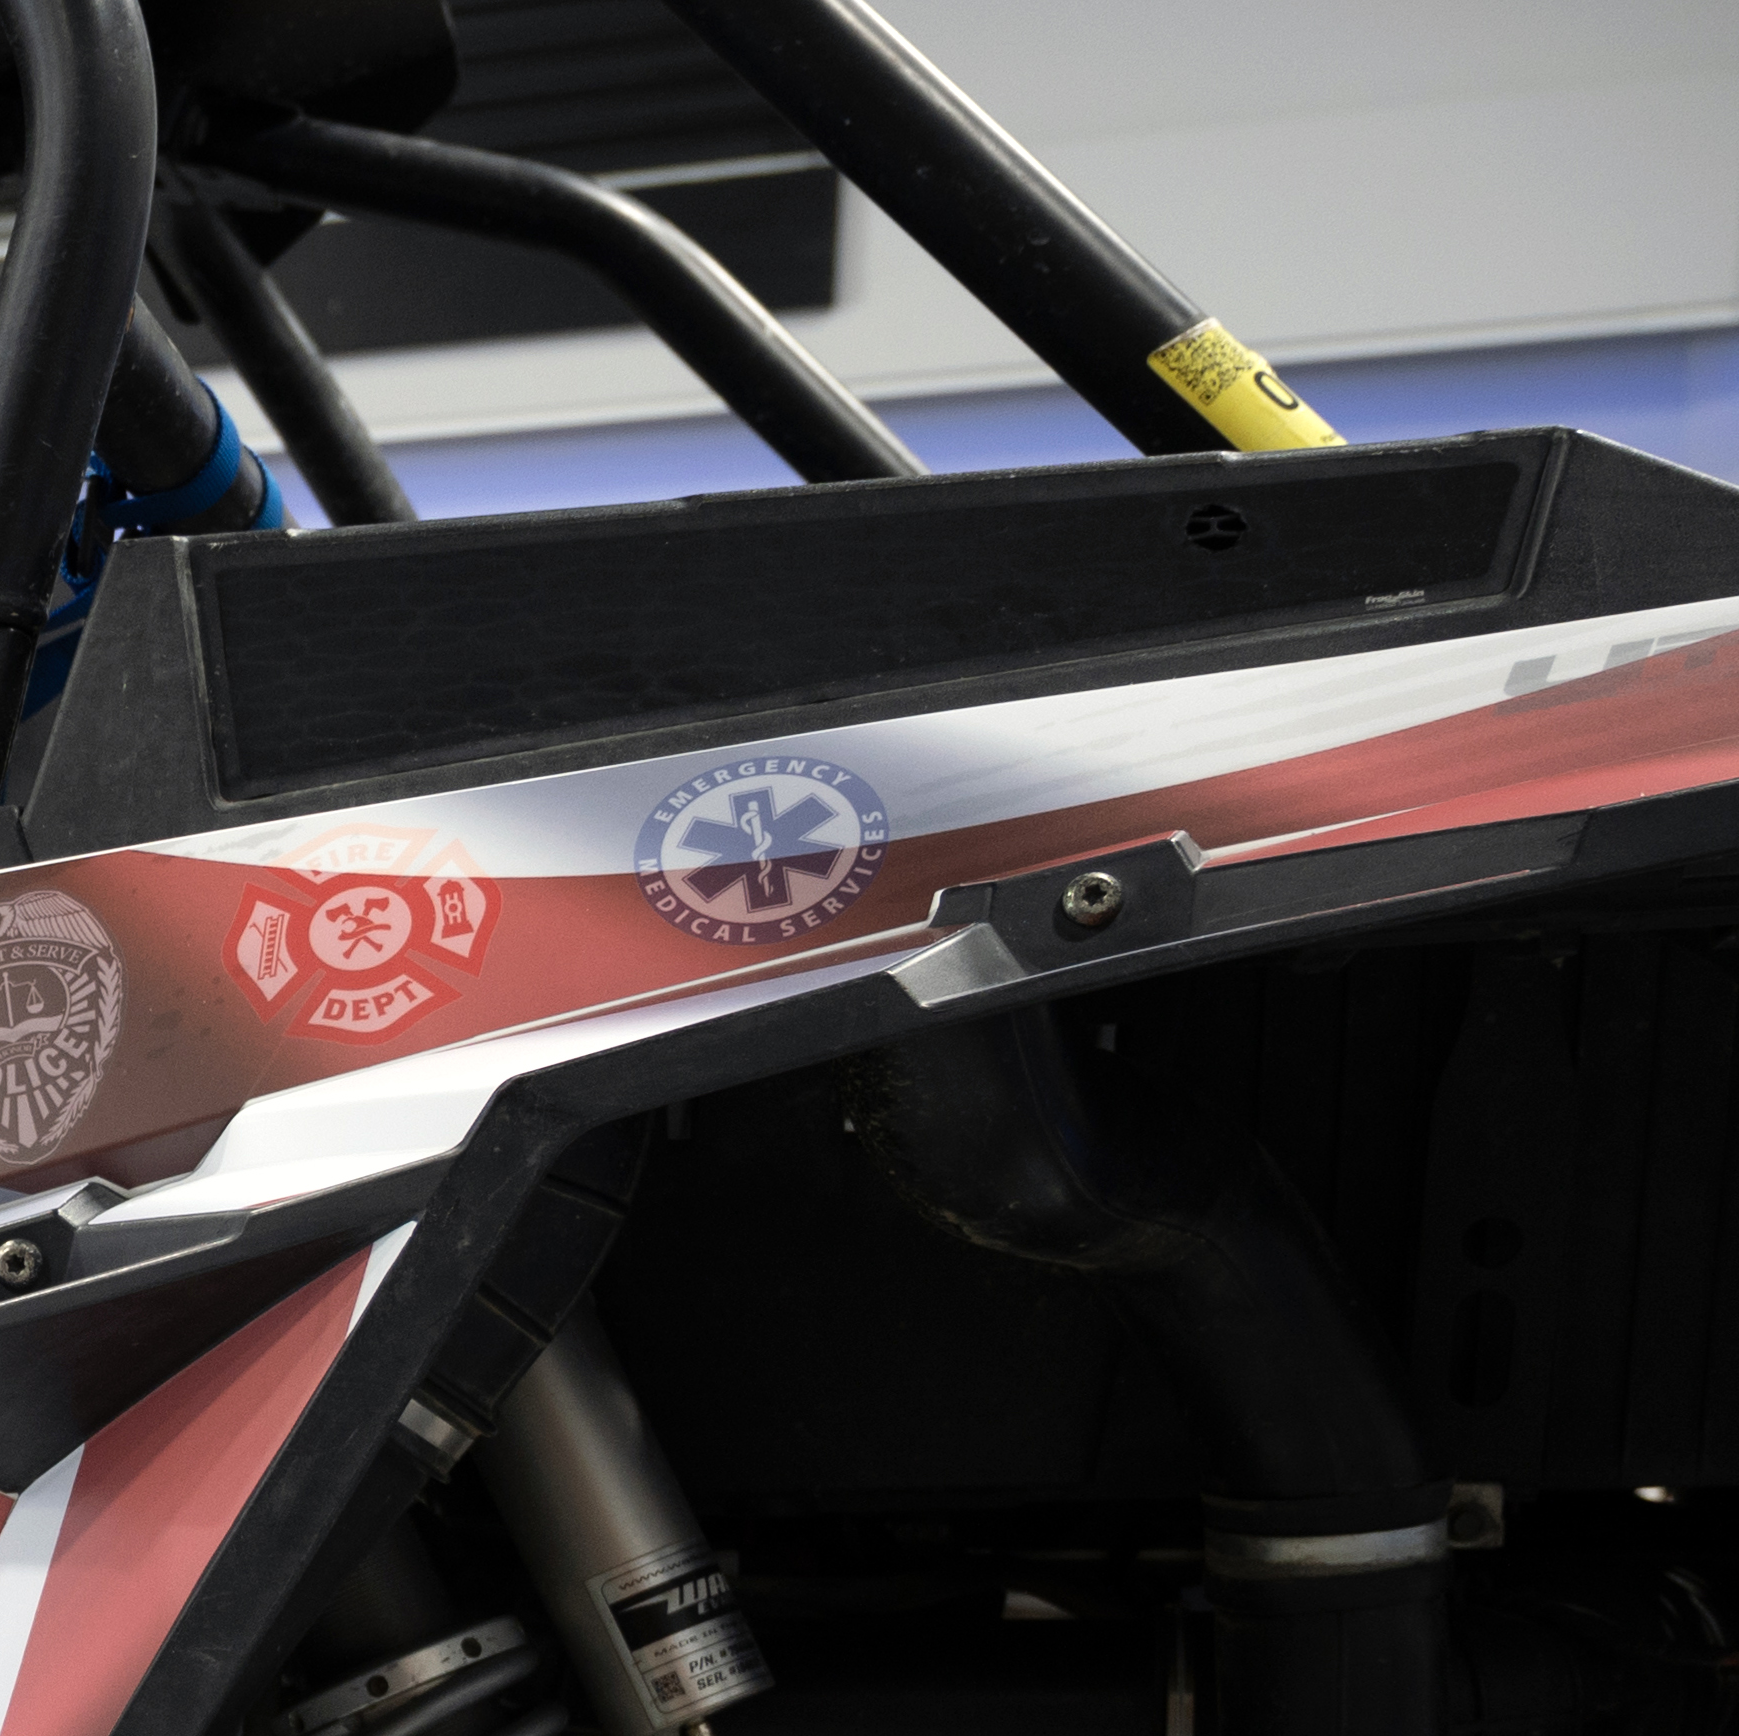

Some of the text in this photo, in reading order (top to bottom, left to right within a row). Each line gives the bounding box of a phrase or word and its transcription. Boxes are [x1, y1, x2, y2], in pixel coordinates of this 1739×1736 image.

[654, 759, 852, 823] EMERGENCY
[305, 842, 397, 877] FIRE
[639, 810, 885, 943] MEDICAL SERVICES
[10, 944, 25, 959] &
[27, 943, 83, 964] SERVE
[321, 979, 418, 1023] DEPT
